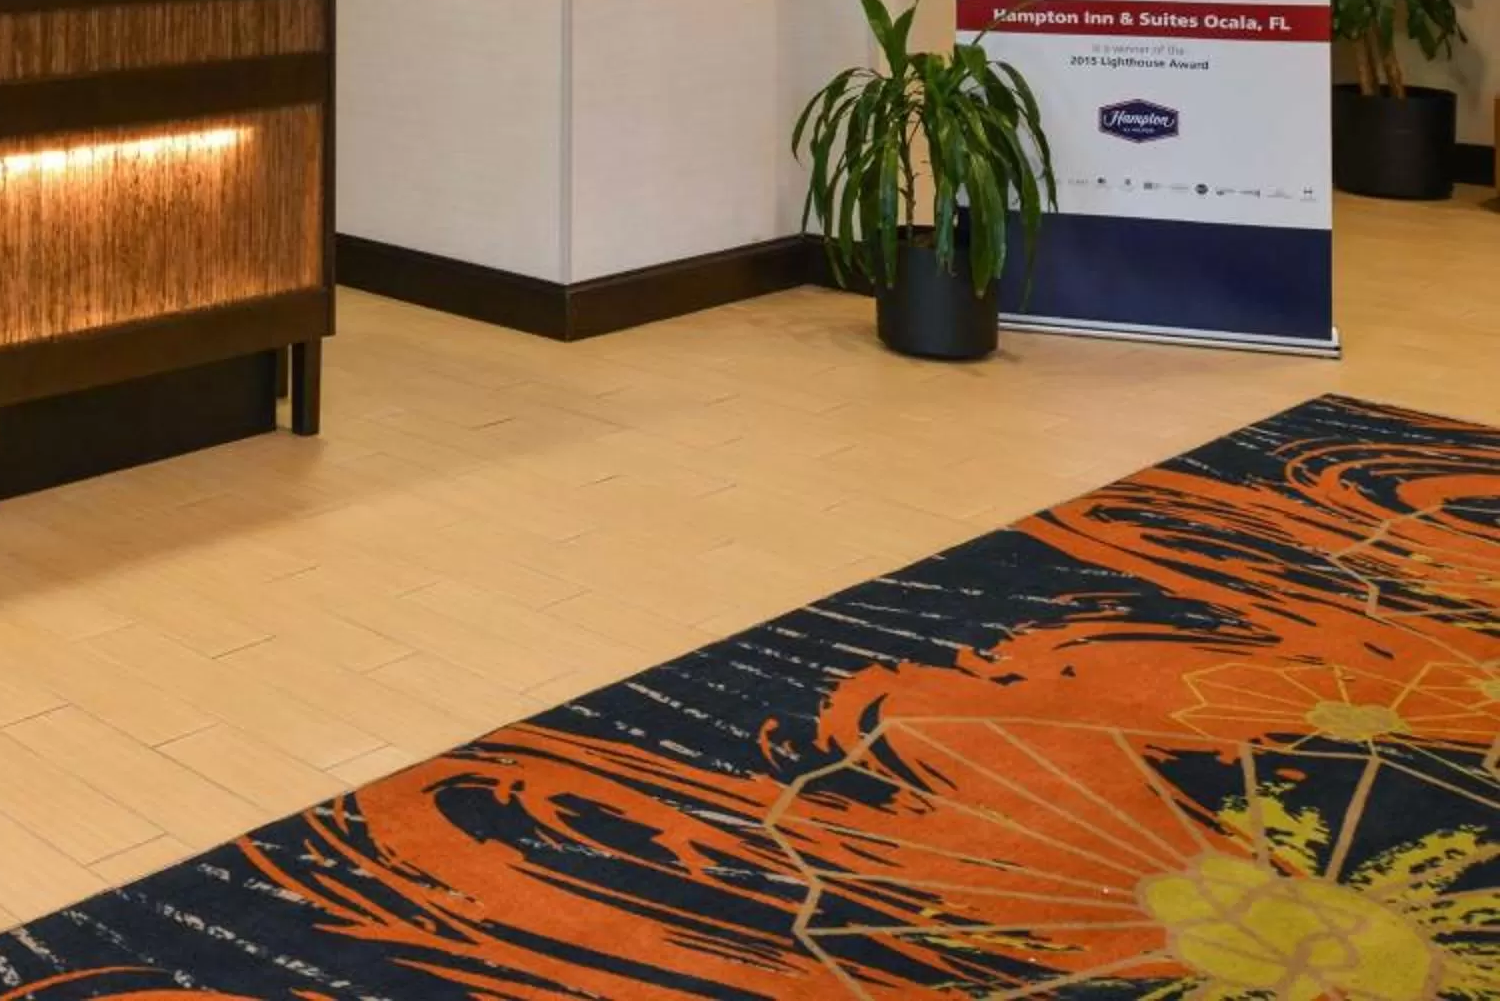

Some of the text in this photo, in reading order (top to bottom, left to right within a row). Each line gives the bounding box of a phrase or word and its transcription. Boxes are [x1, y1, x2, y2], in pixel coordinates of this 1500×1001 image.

[993, 8, 1291, 32] Hampton Inn & Suites Ocala, FL
[1069, 56, 1209, 70] 2015 Lighthouse Award
[1103, 109, 1175, 128] Hampton
